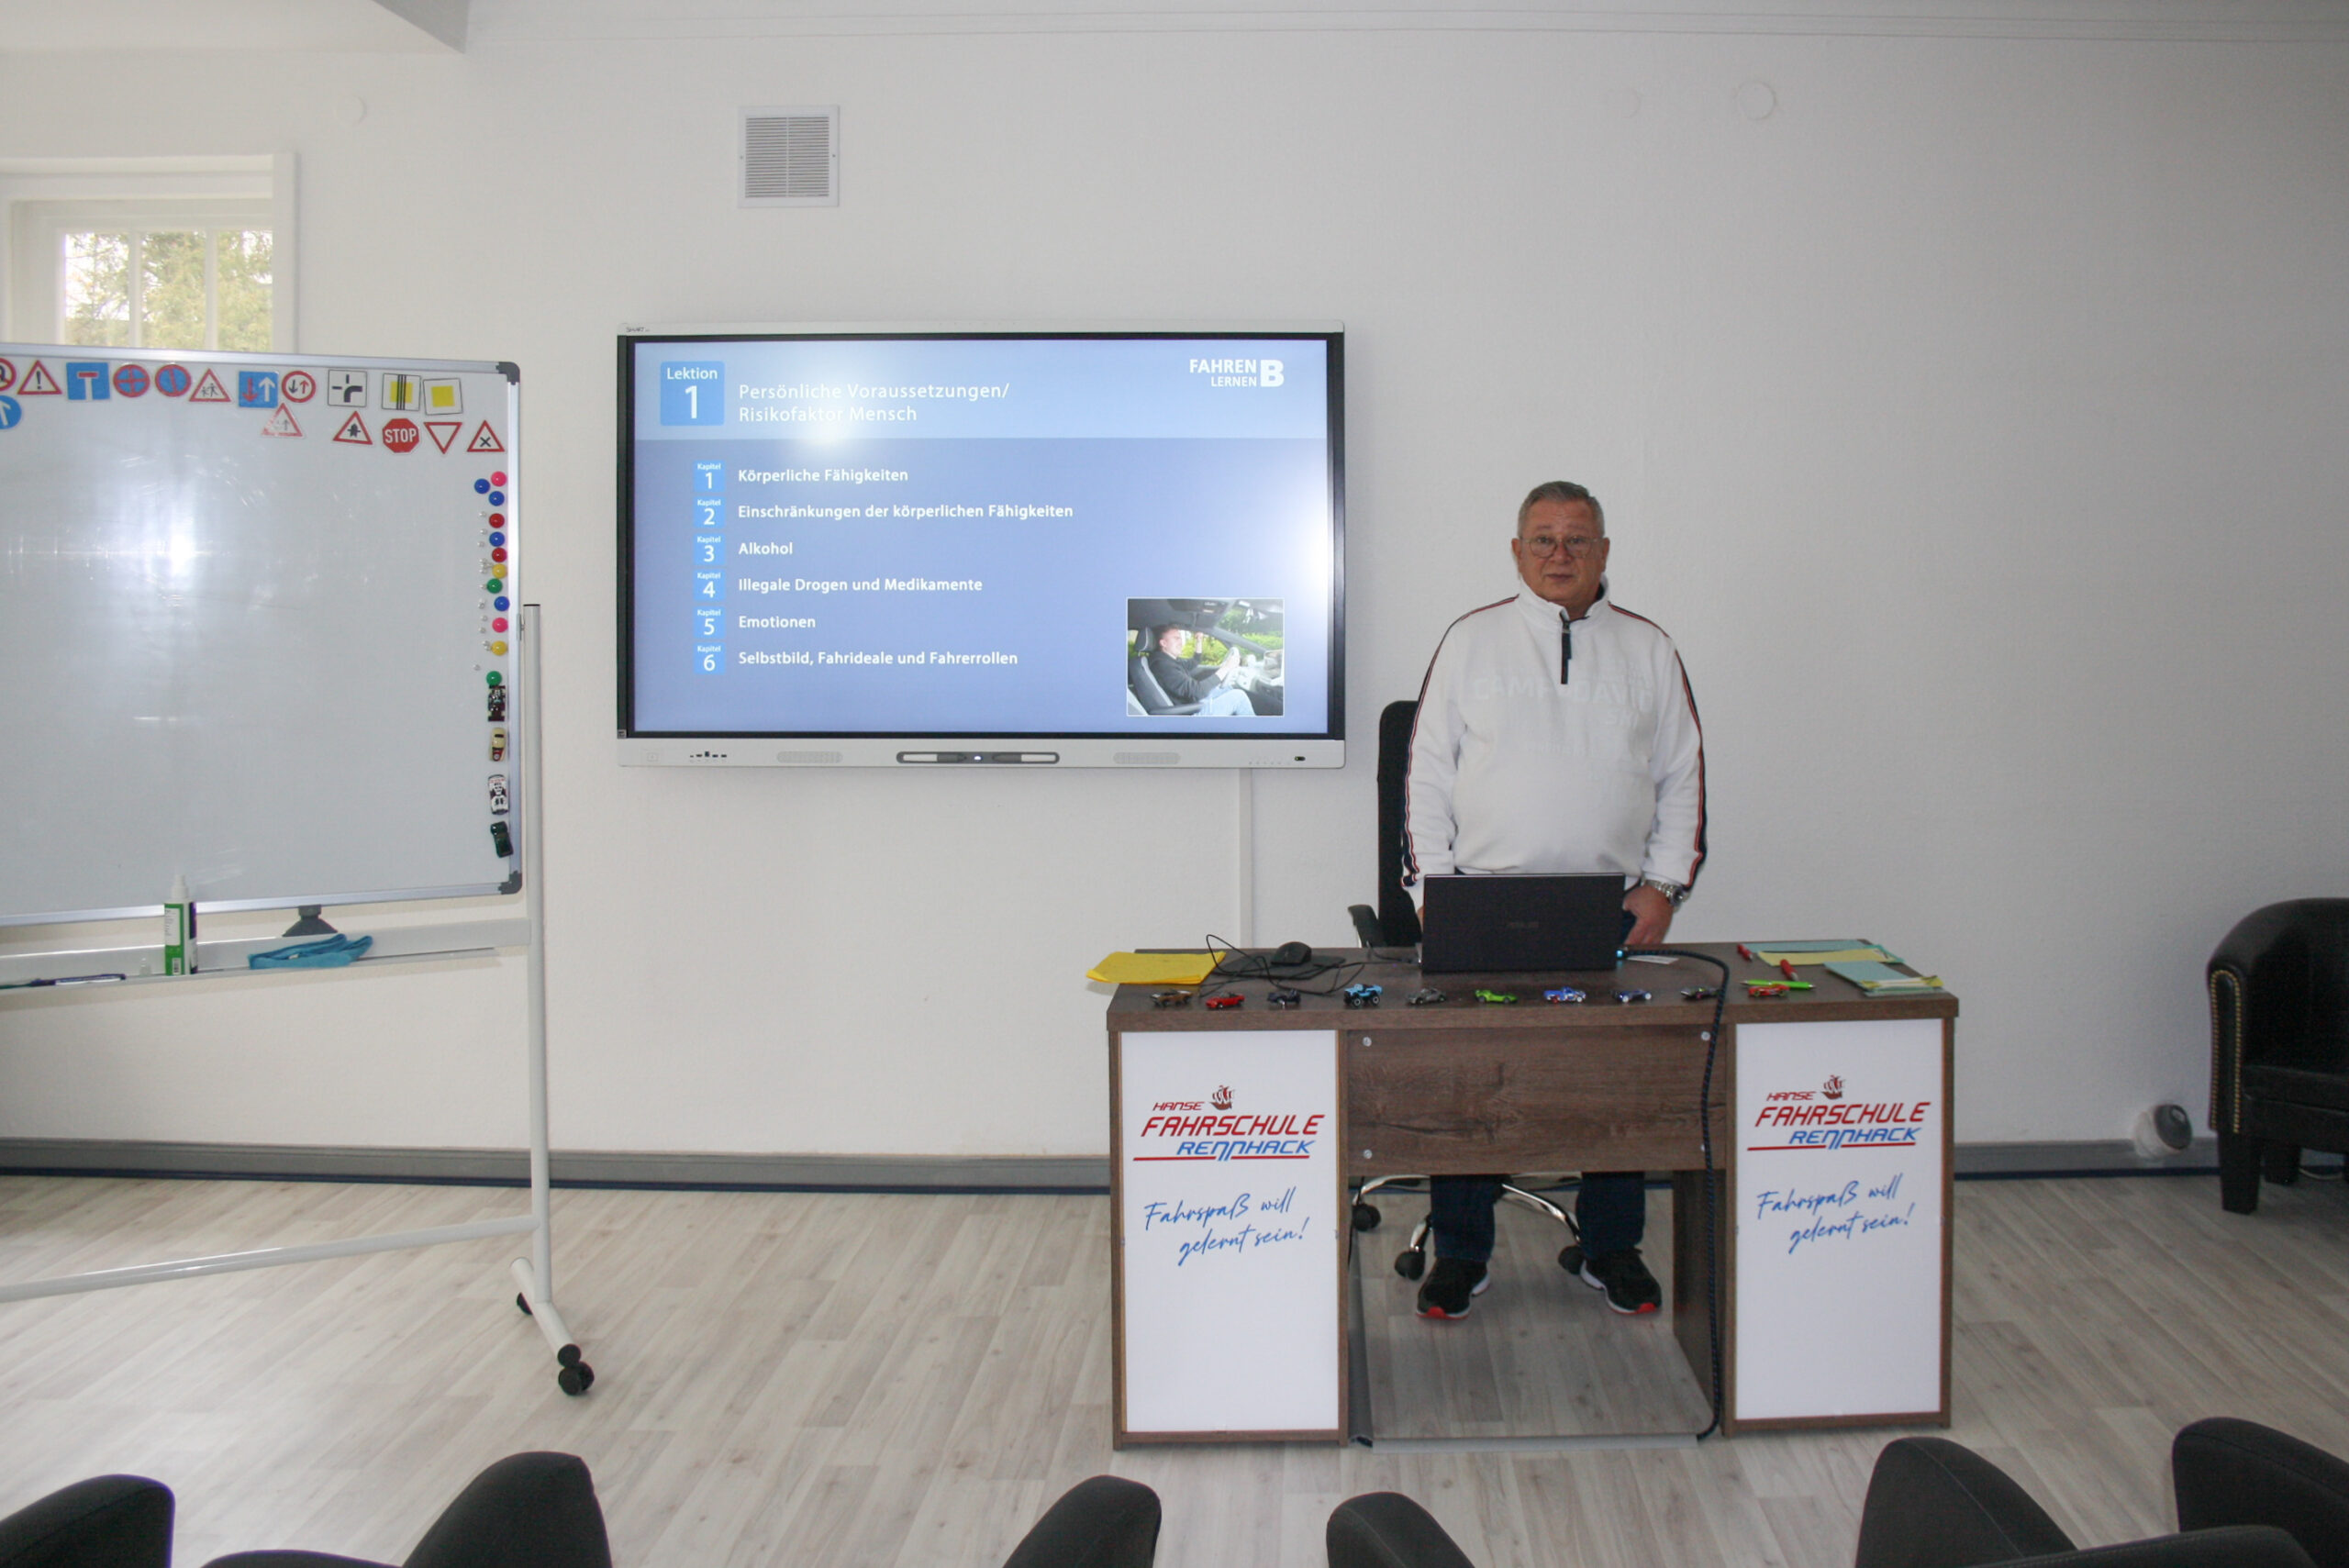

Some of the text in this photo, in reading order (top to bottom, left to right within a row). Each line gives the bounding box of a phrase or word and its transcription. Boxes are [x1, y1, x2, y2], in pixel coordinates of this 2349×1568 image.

[666, 366, 718, 380] Lektion
[1189, 359, 1257, 373] FAHREN
[1260, 359, 1285, 387] B
[1210, 376, 1257, 387] LERNEN
[739, 383, 1010, 402] Persönliche Voraussetzungen/
[685, 384, 697, 419] 1
[739, 405, 918, 422] Risikofaktor Mensch
[385, 428, 417, 443] STOP
[696, 462, 721, 472] Kapitel
[705, 472, 713, 490] 1
[738, 468, 908, 485] Körperliche Fähigkeiten
[696, 498, 721, 507] Kapitel
[703, 507, 716, 526] 2
[738, 504, 1074, 521] Einschränkungen der körperlichen Fähigkeiten
[696, 535, 721, 544] Kapitel
[738, 541, 793, 555] Alkohol
[704, 544, 715, 562] 3
[696, 572, 721, 581] Kapitel
[703, 581, 716, 598] 4
[739, 577, 983, 595] Illegale Drogen und Medikamente
[696, 608, 721, 617] Kapitel
[704, 617, 715, 636] 5
[739, 615, 816, 628] Emotionen
[696, 644, 721, 653] Kapitel
[703, 653, 716, 672] 6
[739, 651, 1019, 667] Selbstbild, Fahrideale und Fahrerrollen
[1765, 1091, 1817, 1101] HANSE
[1152, 1101, 1206, 1111] HANSE
[1755, 1102, 1932, 1128] FAHRSCHULE
[1141, 1114, 1326, 1138] FAHRSCHULE
[1788, 1127, 1922, 1151] RENNHACK
[1175, 1140, 1316, 1162] RENNHACK
[1756, 1173, 1904, 1220] Fahrspaß will
[1143, 1185, 1297, 1231] Fahrspaß will
[1788, 1202, 1916, 1255] gelernt sein!
[1177, 1217, 1310, 1267] gelernt sein!
